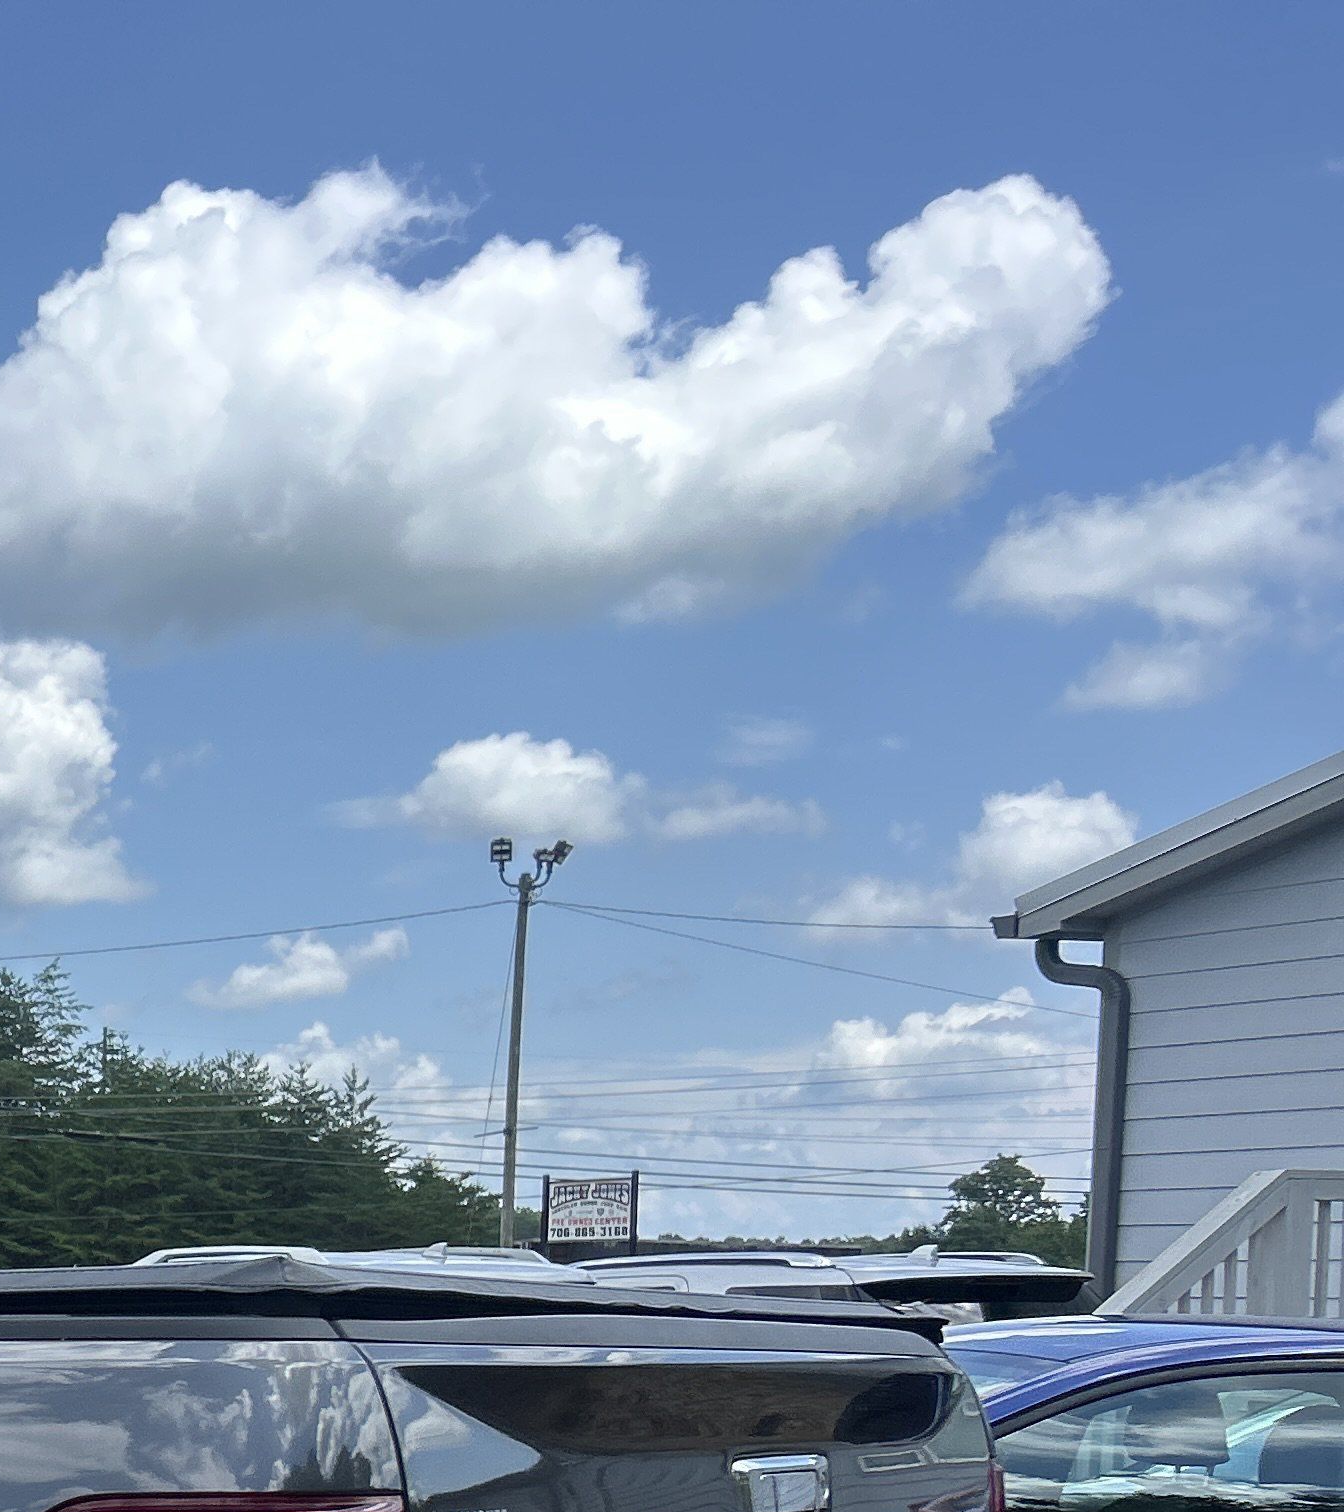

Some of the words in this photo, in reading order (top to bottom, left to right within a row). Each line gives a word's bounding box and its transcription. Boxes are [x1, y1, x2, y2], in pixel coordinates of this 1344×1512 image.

[550, 1184, 590, 1209] JACKY
[591, 1182, 630, 1207] JONES
[595, 1215, 628, 1226] CENTER
